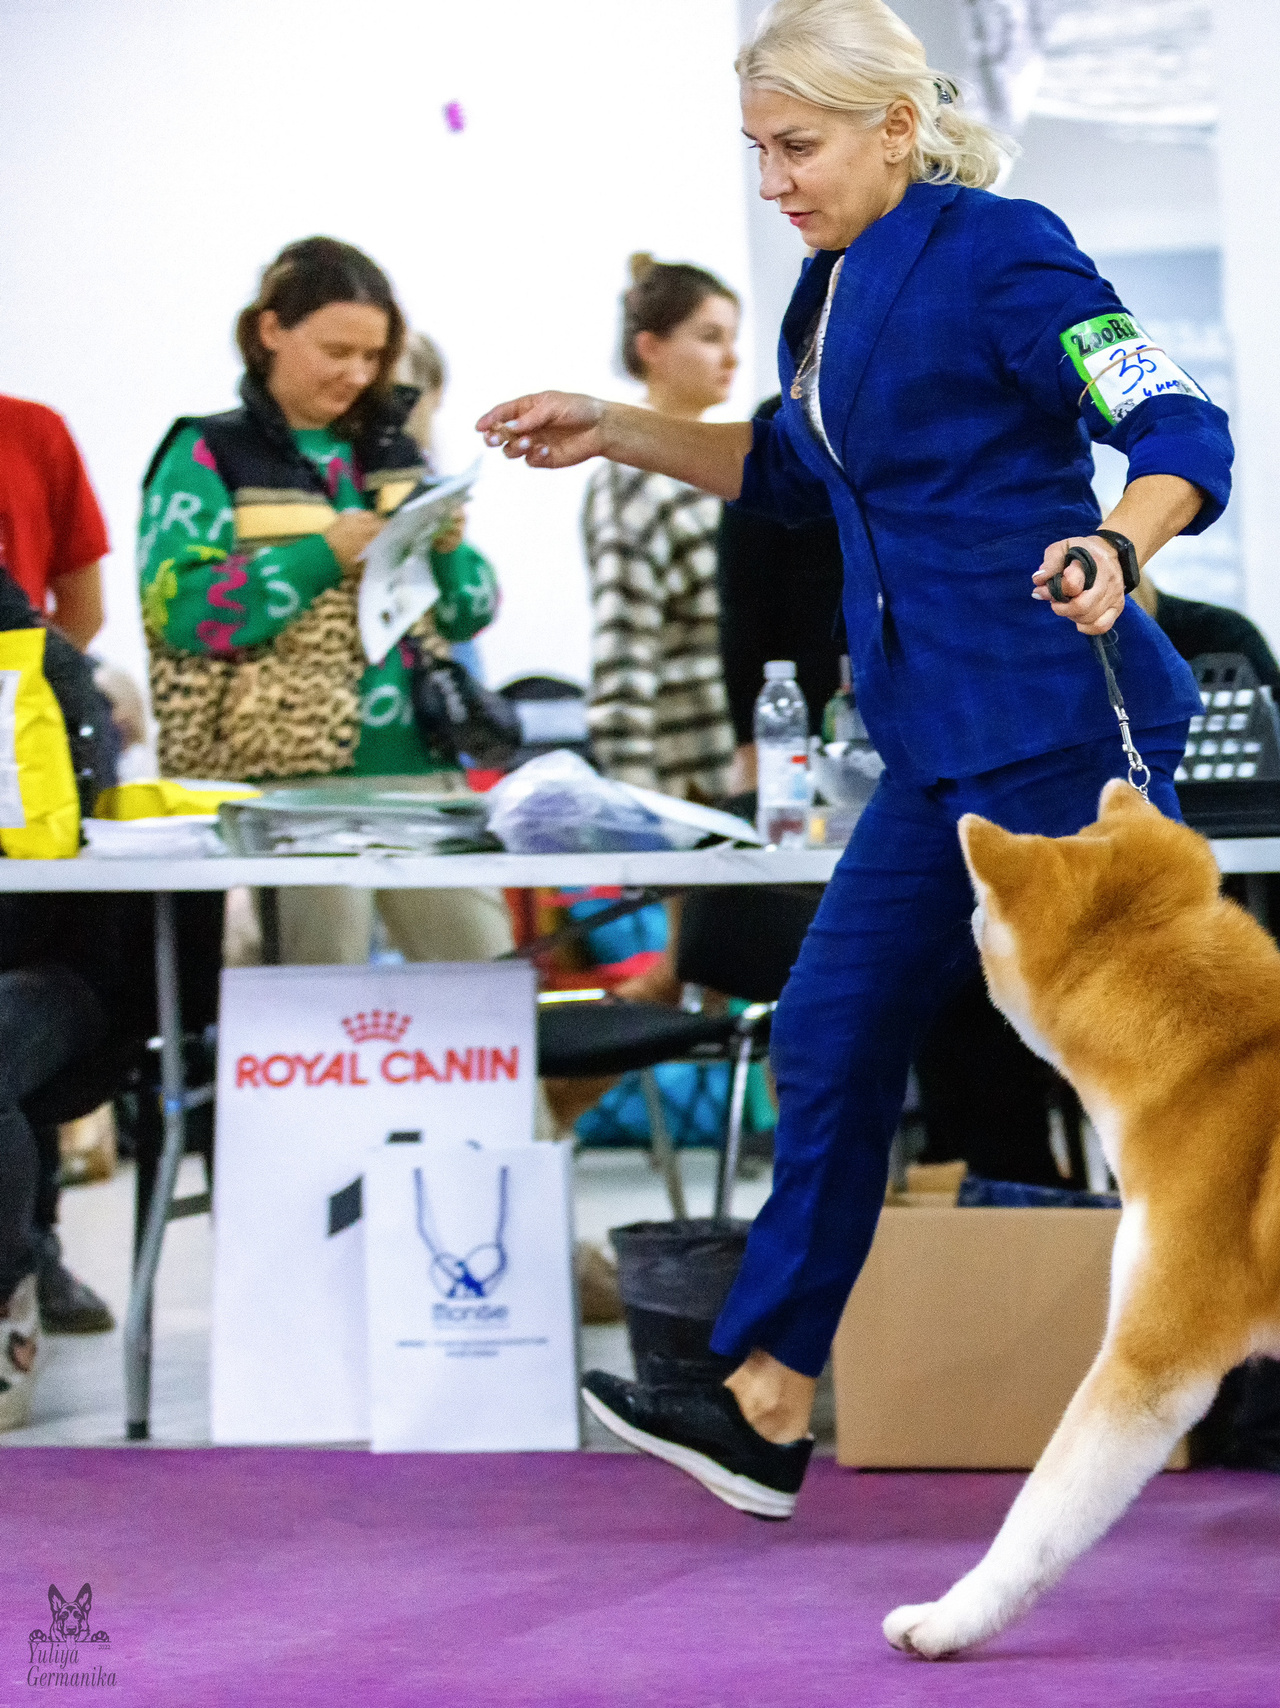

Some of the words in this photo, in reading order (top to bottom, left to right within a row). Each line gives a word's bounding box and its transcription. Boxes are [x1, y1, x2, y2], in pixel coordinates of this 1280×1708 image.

[1109, 344, 1157, 395] 35
[236, 1051, 367, 1088] ROYAL
[381, 1046, 519, 1083] CANIN
